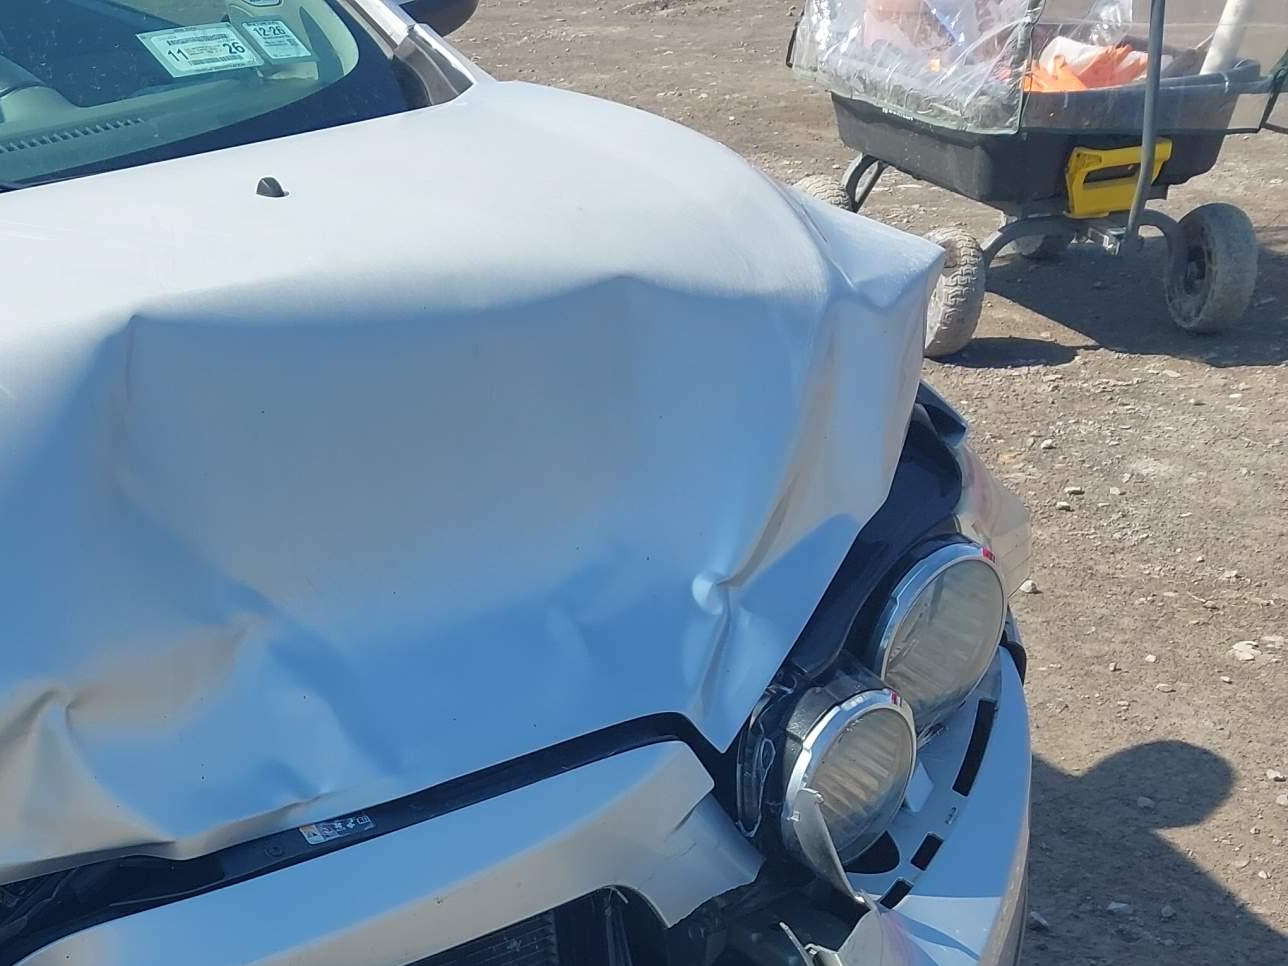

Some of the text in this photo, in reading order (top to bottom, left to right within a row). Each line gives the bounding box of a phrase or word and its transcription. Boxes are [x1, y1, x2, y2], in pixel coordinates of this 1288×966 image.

[253, 25, 286, 37] 12-26
[167, 48, 189, 62] 11
[222, 41, 246, 55] 26
